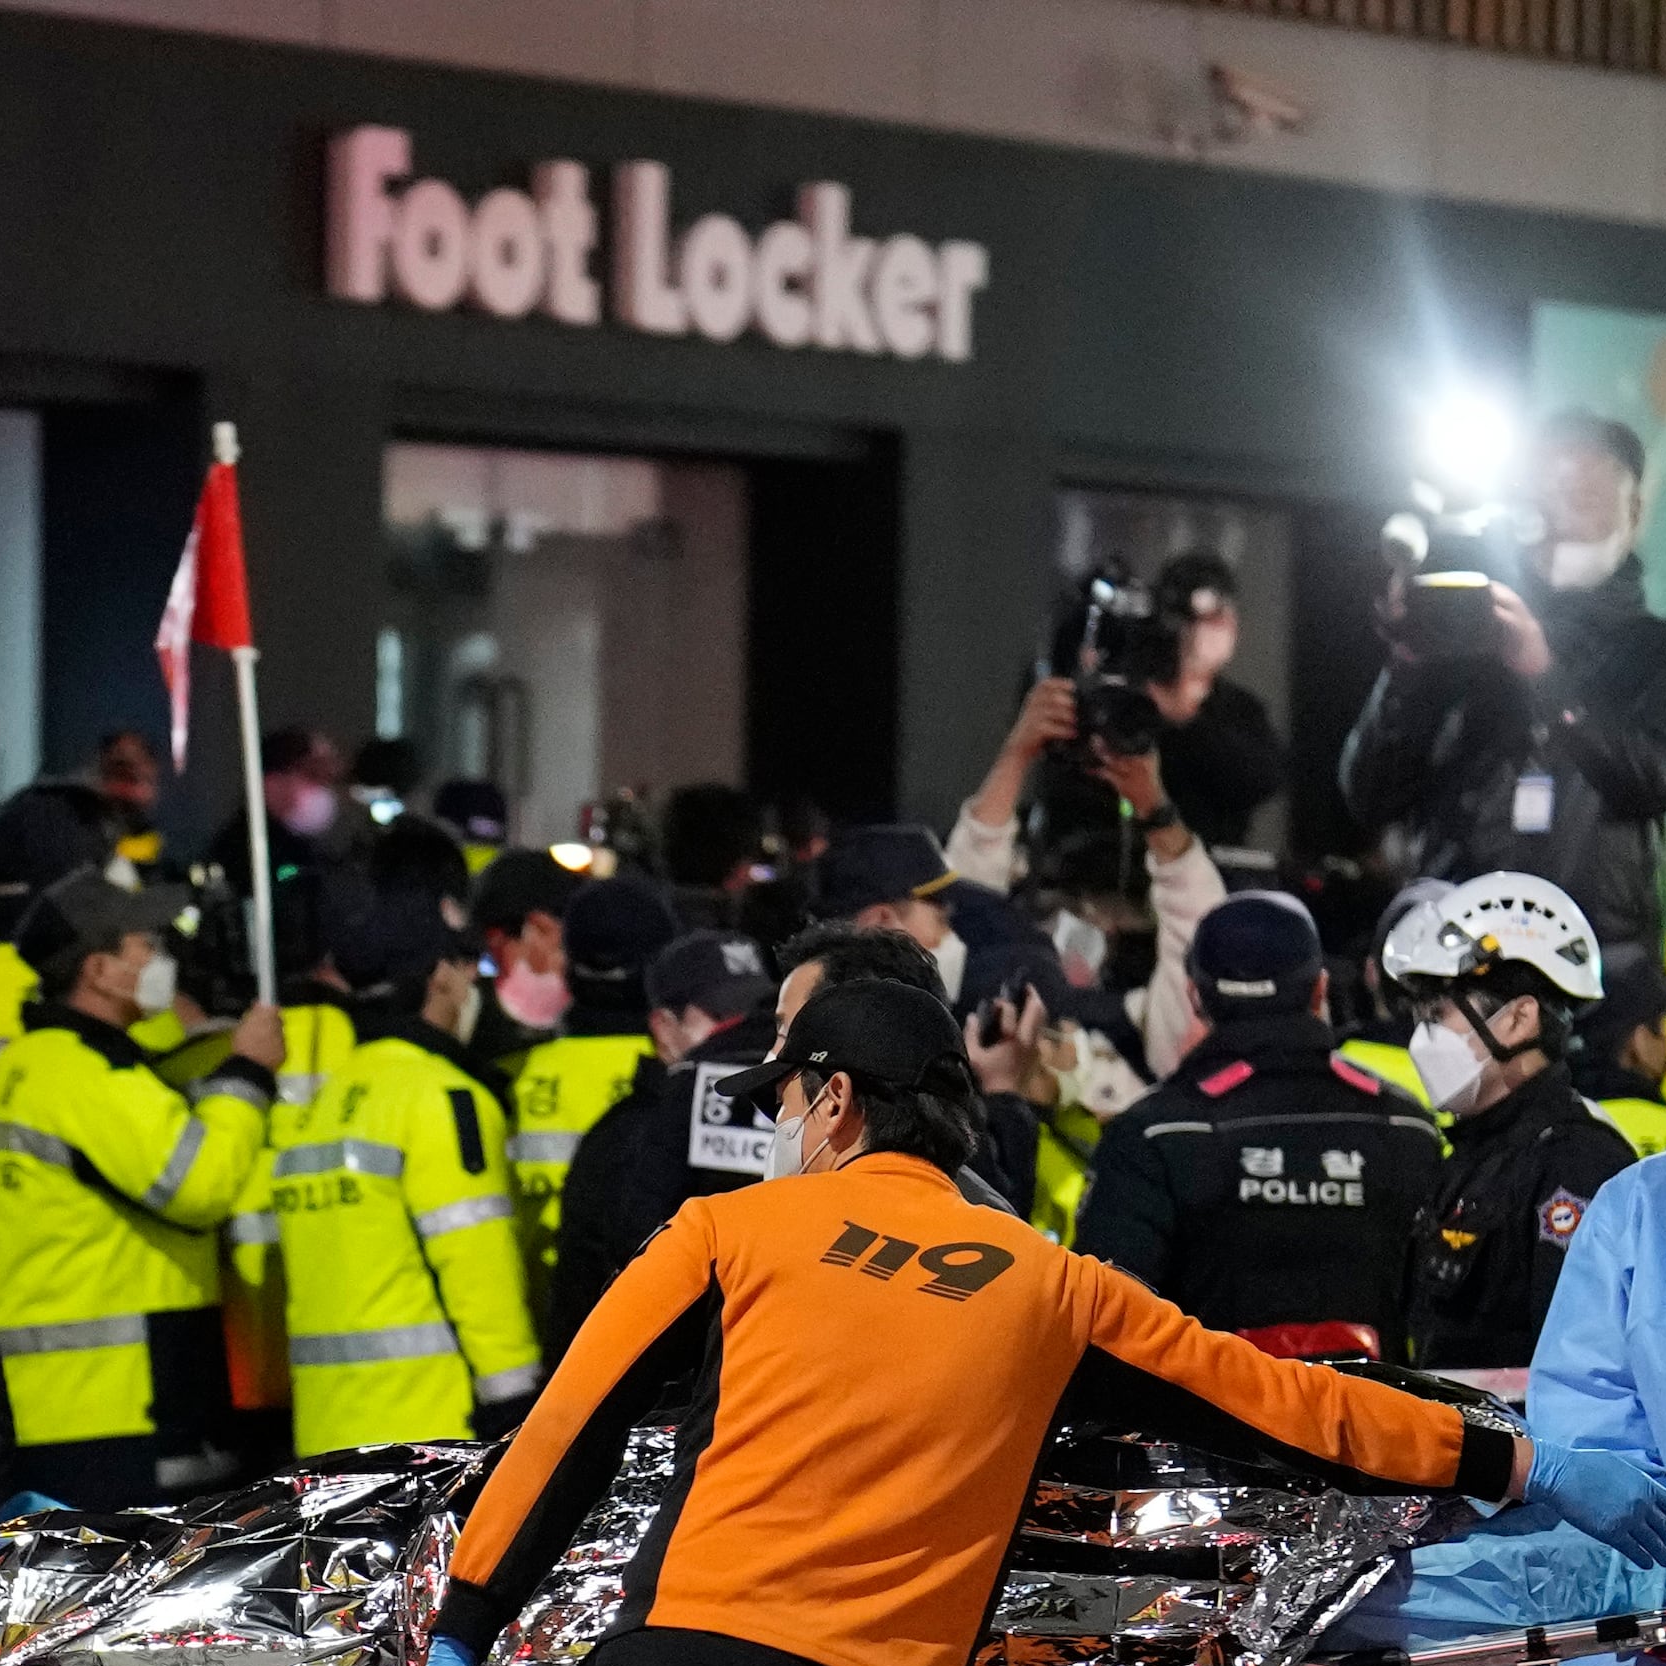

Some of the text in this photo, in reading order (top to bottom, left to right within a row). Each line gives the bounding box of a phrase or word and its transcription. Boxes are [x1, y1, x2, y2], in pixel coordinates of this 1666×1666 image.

[326, 124, 989, 363] Foot Locker
[808, 1051, 828, 1063] 119
[703, 1134, 767, 1160] POLIC
[1239, 1178, 1366, 1207] POLICE
[819, 1220, 1016, 1303] 119
